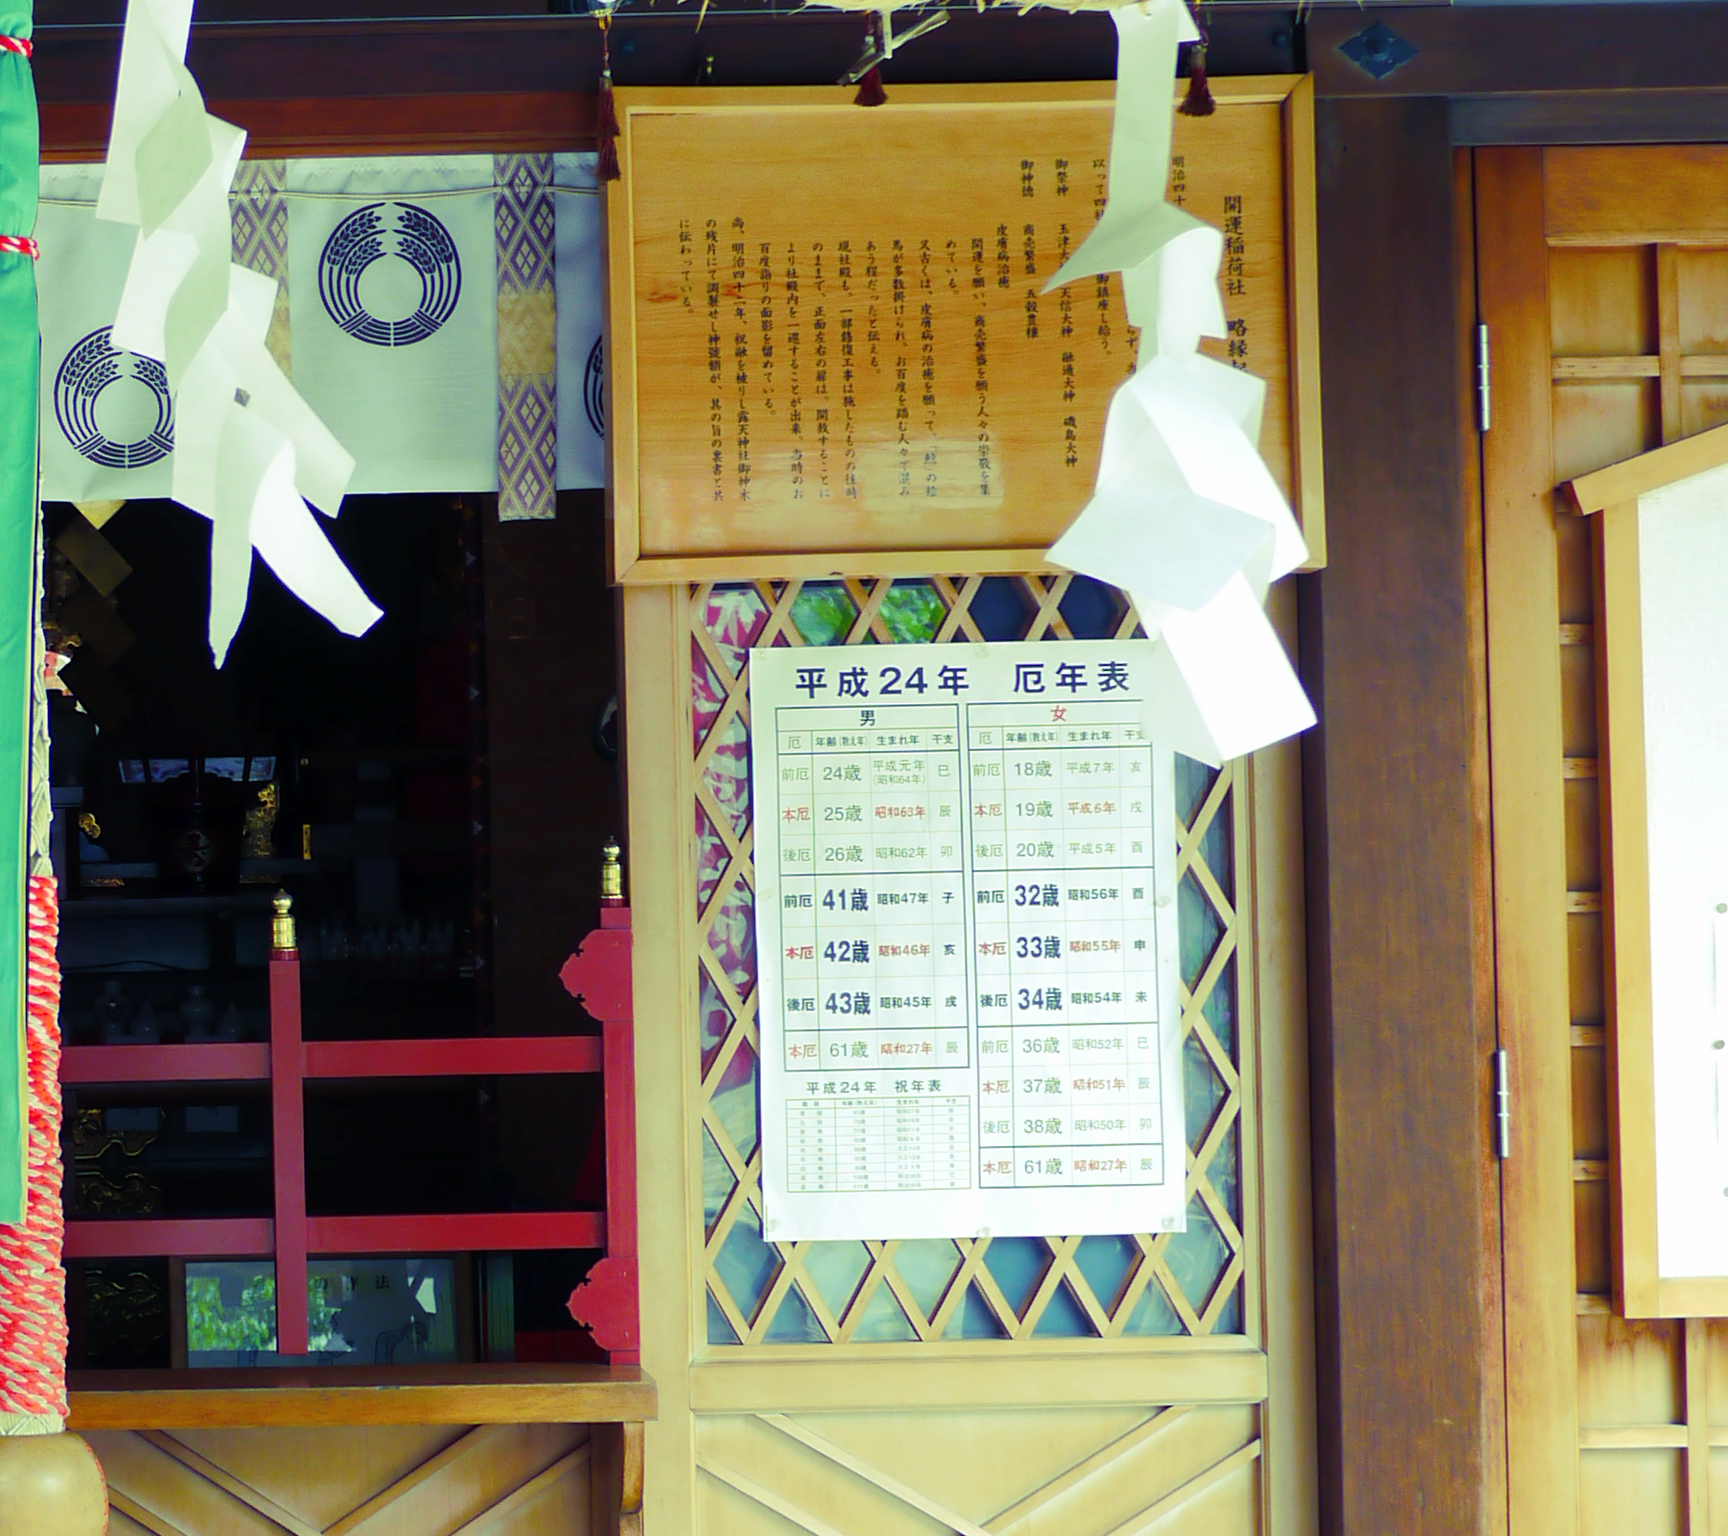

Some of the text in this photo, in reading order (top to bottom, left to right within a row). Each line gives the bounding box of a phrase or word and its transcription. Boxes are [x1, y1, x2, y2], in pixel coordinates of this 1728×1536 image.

[1223, 196, 1246, 296] 開運稲荷社
[795, 661, 1129, 698] 平成24年 厄年表
[860, 710, 876, 726] 男
[1051, 706, 1067, 722] 女
[787, 735, 802, 750] 厄
[978, 732, 992, 745] 厄
[822, 765, 862, 782] 24歳
[1014, 761, 1052, 778] 18歳
[1066, 762, 1115, 775] 平成7年
[782, 807, 810, 822] 本厄
[823, 805, 862, 822] 25歳
[974, 803, 1002, 817] 本厄
[1015, 801, 1053, 818] 19歳
[825, 845, 863, 863] 26歳
[875, 845, 927, 859] 昭和62年
[1016, 841, 1055, 858] 20歳
[1068, 842, 1116, 855] 平成5年
[784, 889, 954, 912] 前厄 41歳 昭和47年 子
[977, 889, 1005, 904] 前厄
[1014, 884, 1059, 907] 32歳
[1067, 888, 1119, 900] 昭和56年
[785, 945, 814, 960] 本厄
[823, 941, 870, 964] 42歳
[878, 944, 930, 958] 昭和46年
[978, 941, 1007, 956] 本厄
[1016, 936, 1061, 959] 33歳
[1070, 940, 1121, 953] 昭和55年
[787, 997, 815, 1012] 後厄
[825, 993, 871, 1015] 43歳
[880, 996, 932, 1009] 昭和45年
[980, 994, 1008, 1009] 後厄
[1018, 988, 1062, 1011] 34歳
[1071, 992, 1122, 1005] 昭和54年
[788, 1044, 817, 1059] 本厄
[829, 1042, 868, 1059] 61歳
[880, 1042, 932, 1055] 昭和27年
[981, 1040, 1009, 1055] 前厄
[1022, 1037, 1060, 1055] 36歳
[1072, 1038, 1124, 1051] 昭和52年
[807, 1080, 878, 1094] 平成24年
[982, 1080, 1010, 1095] 本厄
[1023, 1078, 1061, 1095] 37歳
[982, 1120, 1010, 1134] 後厄
[1024, 1118, 1062, 1135] 38歳
[1075, 1118, 1126, 1131] 昭和50年
[983, 1160, 1011, 1175] 本厄
[1024, 1158, 1063, 1175] 61歳
[1074, 1158, 1127, 1173] 昭和27年
